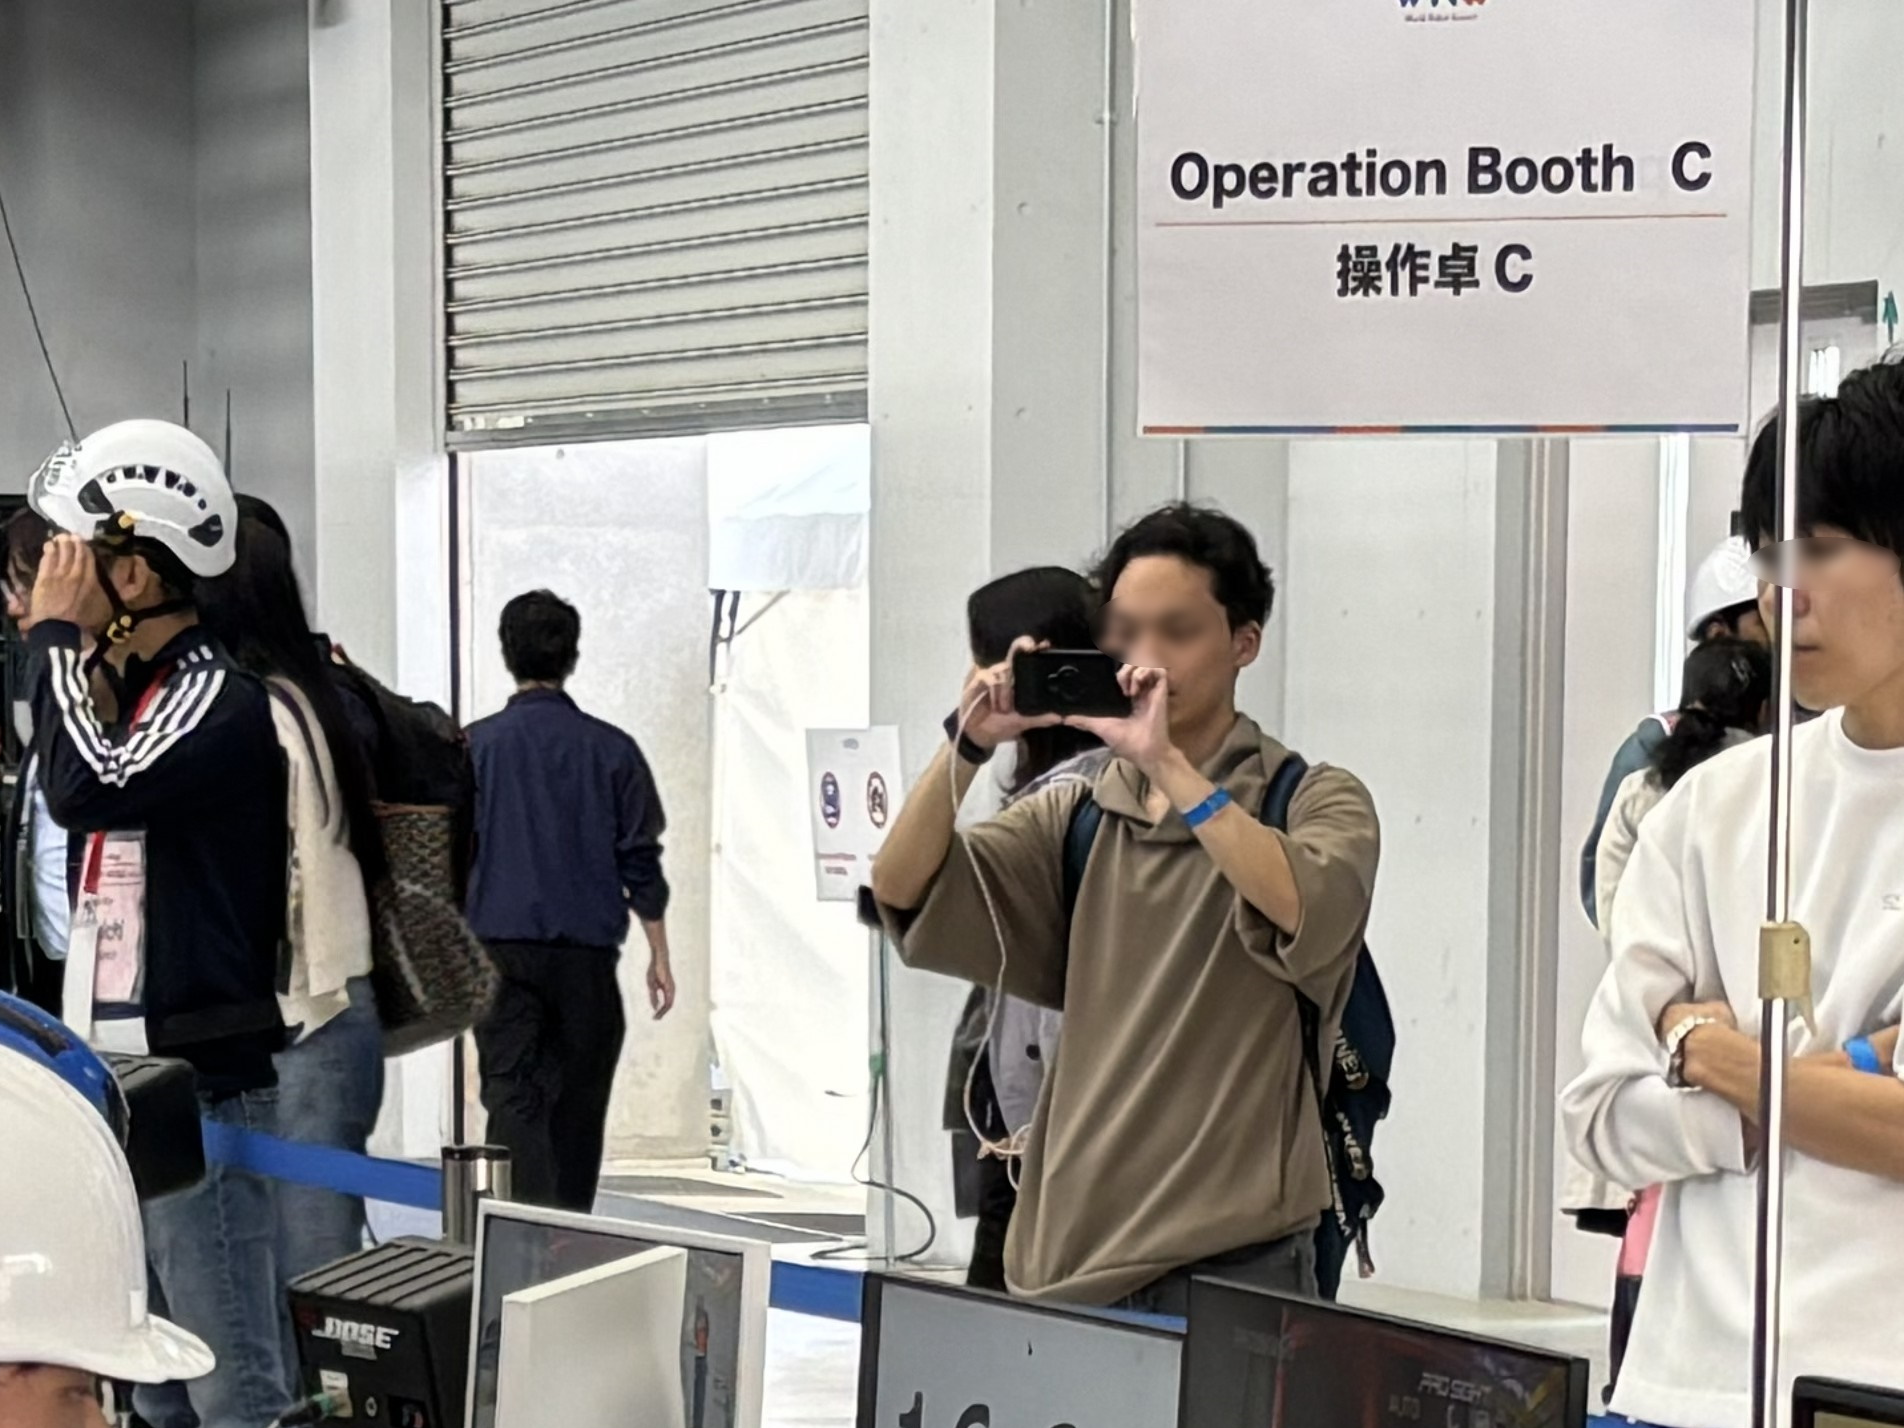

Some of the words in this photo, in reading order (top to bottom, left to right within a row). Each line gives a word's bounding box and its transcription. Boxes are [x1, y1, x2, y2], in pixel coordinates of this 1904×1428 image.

[1170, 149, 1447, 209] Operation
[1467, 143, 1635, 195] Booth
[1671, 140, 1713, 192] C
[1336, 242, 1480, 298] 操作卓
[1495, 243, 1534, 294] C
